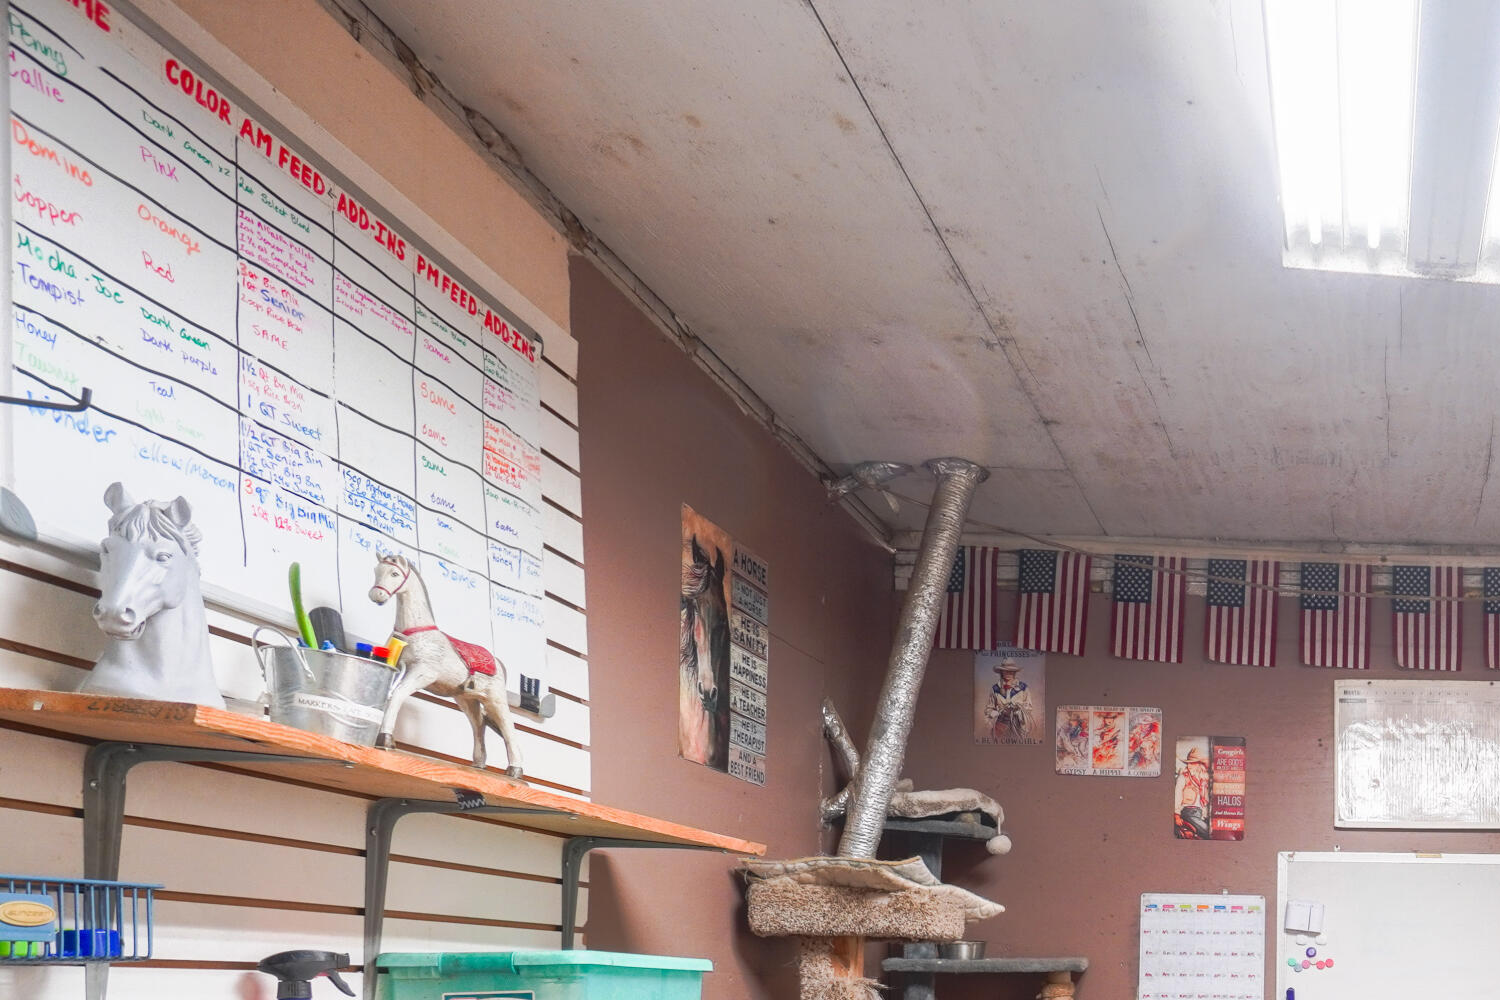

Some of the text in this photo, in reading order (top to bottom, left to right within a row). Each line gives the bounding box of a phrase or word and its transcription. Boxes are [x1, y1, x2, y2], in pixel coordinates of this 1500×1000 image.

[165, 59, 231, 125] COLOR
[140, 146, 178, 182] Pink
[240, 118, 326, 195] AM FEED
[337, 193, 406, 261] ADD-INS
[142, 250, 175, 283] Red
[416, 253, 439, 287] PM
[441, 278, 478, 317] FEED
[15, 312, 57, 350] Honey
[252, 325, 288, 351] SAME
[484, 309, 535, 362] ADD-INS
[741, 553, 766, 585] HORSE
[741, 616, 751, 633] HE
[734, 627, 767, 656] SANITY
[742, 654, 750, 666] HE
[732, 661, 766, 689] HAPPINESS
[741, 686, 750, 699] HE
[739, 698, 765, 719] TEACHER
[741, 720, 750, 732] HE
[734, 729, 764, 751] THERAPIST
[739, 749, 751, 764] AND
[730, 760, 764, 784] BEST FRIEND
[1217, 796, 1241, 806] HALOS
[1217, 819, 1241, 831] Wings
